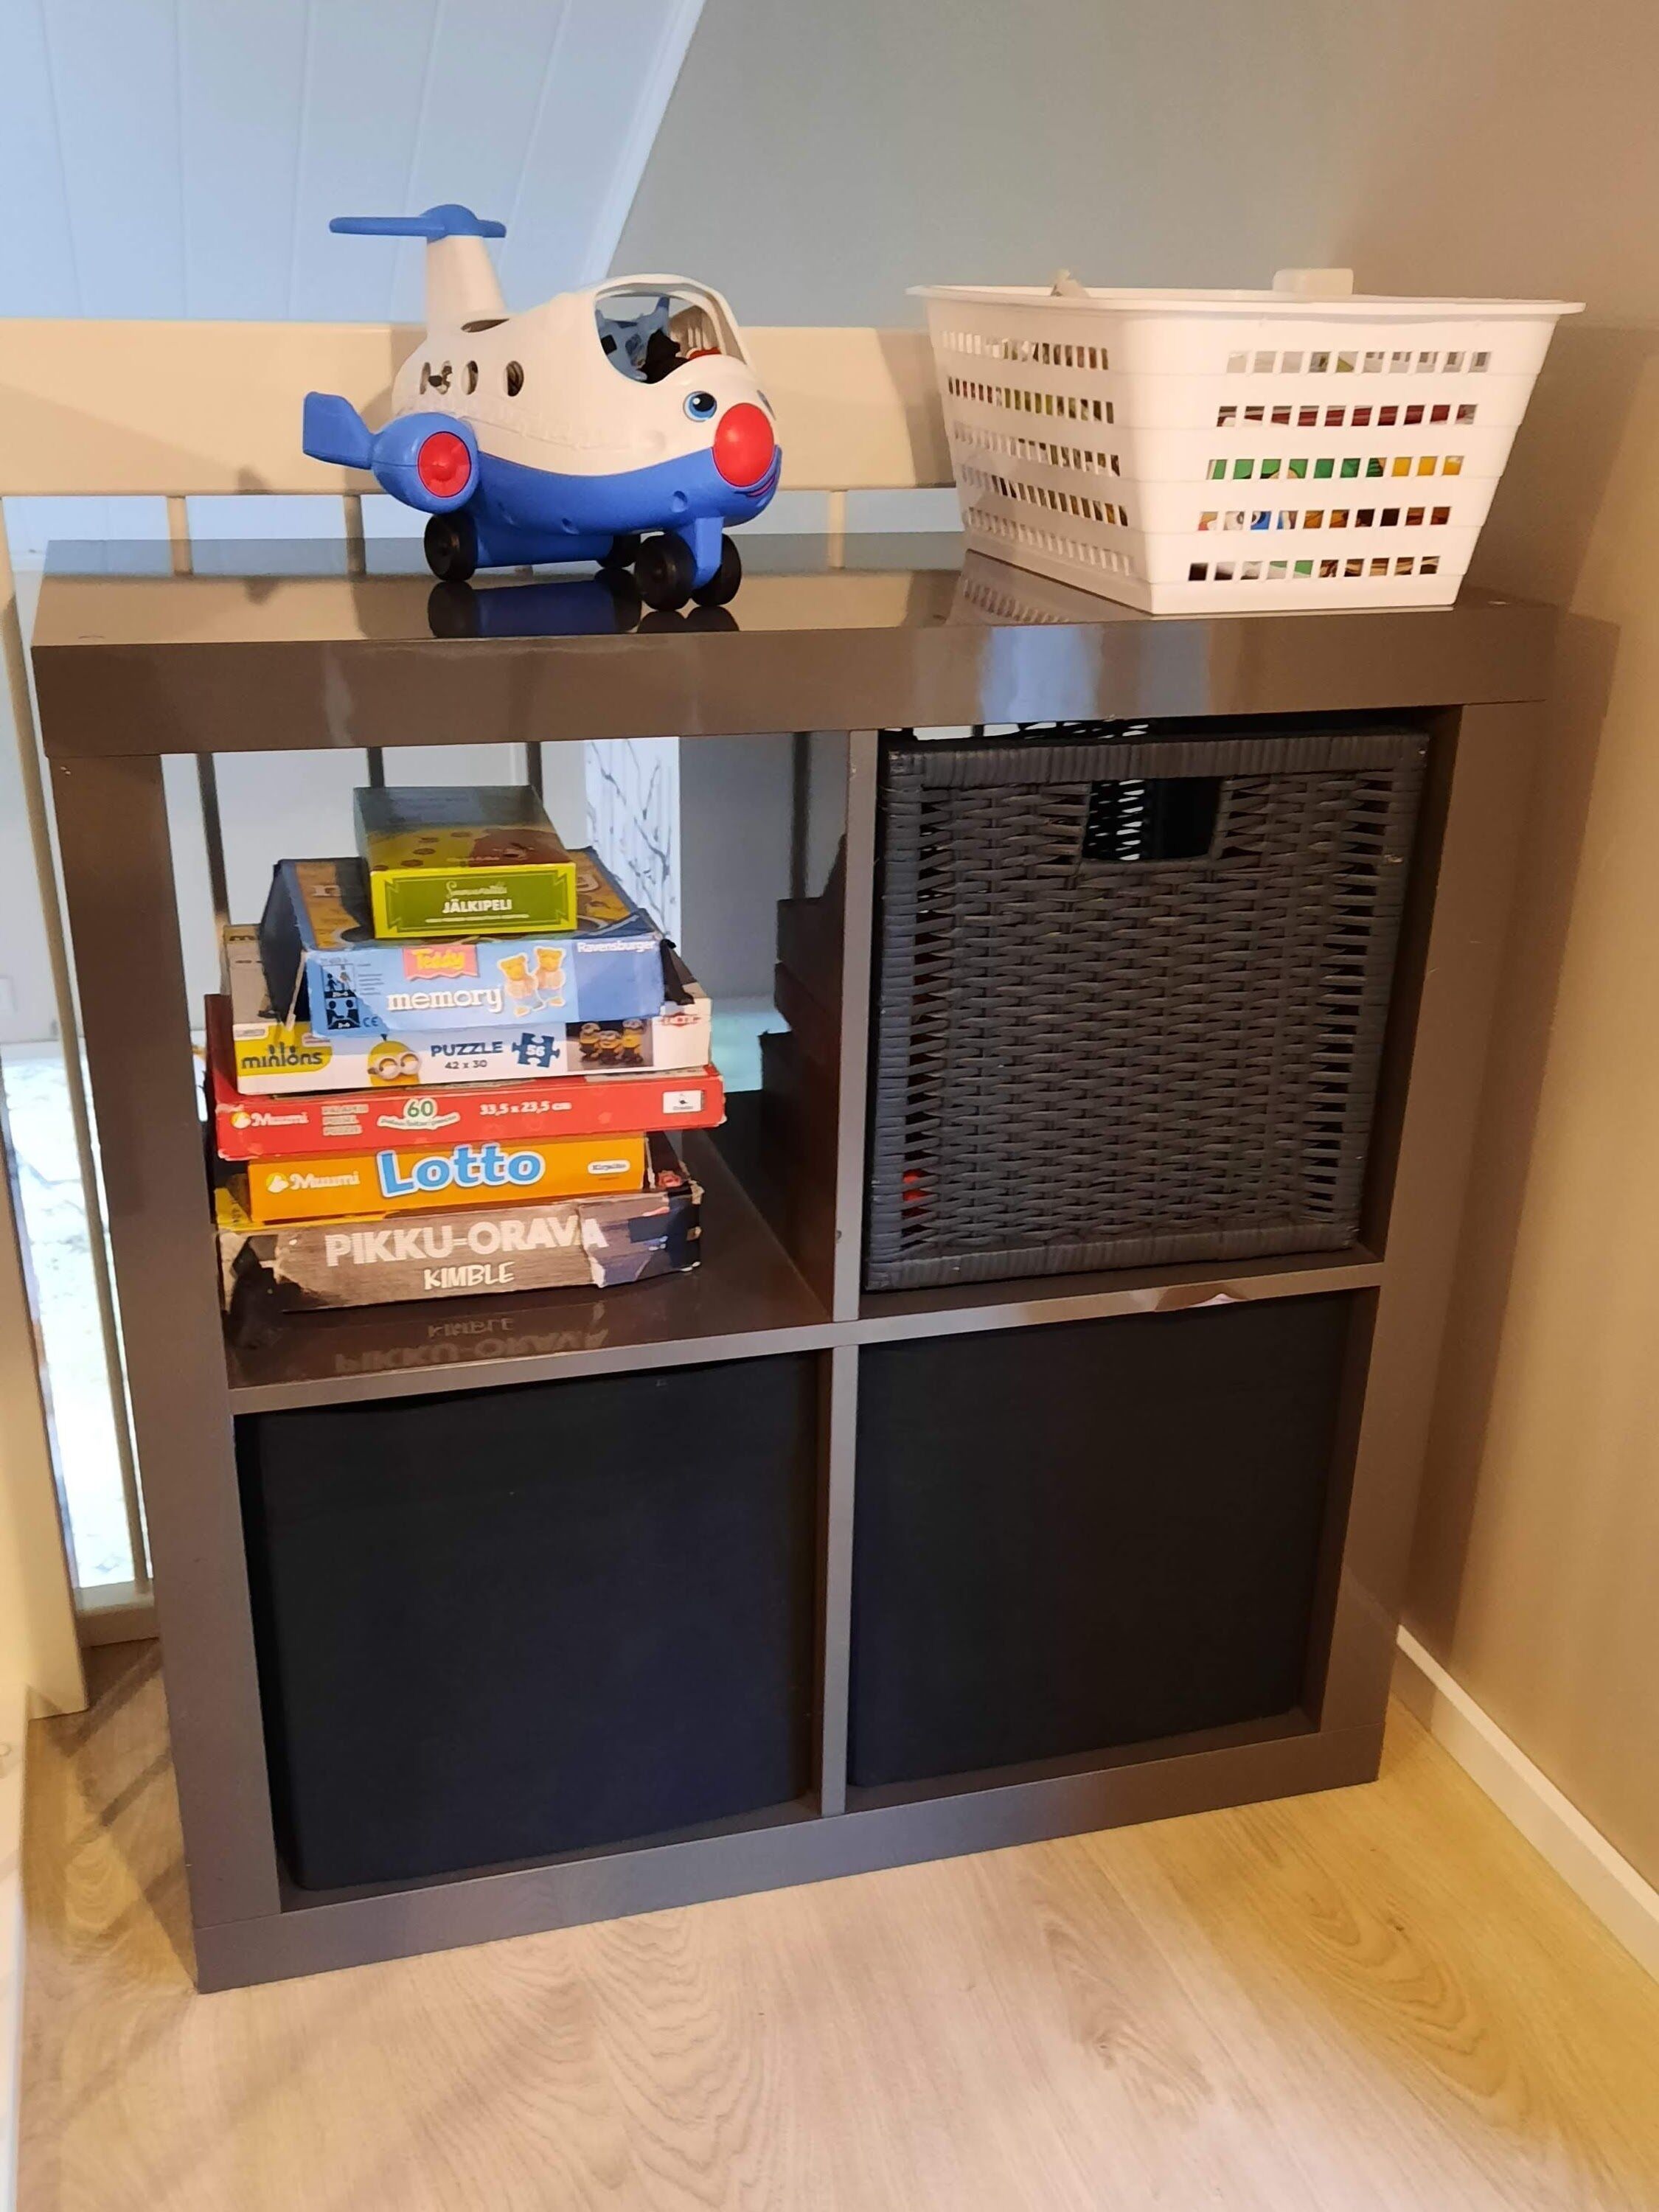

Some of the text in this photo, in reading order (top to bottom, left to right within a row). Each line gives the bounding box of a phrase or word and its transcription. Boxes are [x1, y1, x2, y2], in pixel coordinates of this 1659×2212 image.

[442, 898, 512, 914] JÄLKIPELI
[411, 947, 466, 970] Teddy
[386, 987, 504, 1014] memory
[241, 1042, 323, 1069] minions
[431, 1041, 504, 1057] PUZZLE
[526, 1044, 546, 1057] 56
[445, 1061, 459, 1070] 42
[473, 1060, 488, 1068] 30
[407, 1099, 434, 1119] 60
[479, 1103, 509, 1116] 33,5
[509, 1105, 520, 1113] x
[521, 1101, 550, 1115] 23,5
[378, 1143, 544, 1197] Lotto
[324, 1214, 610, 1267] PIKKU-ORAVA
[423, 1262, 516, 1291] KIMBLE
